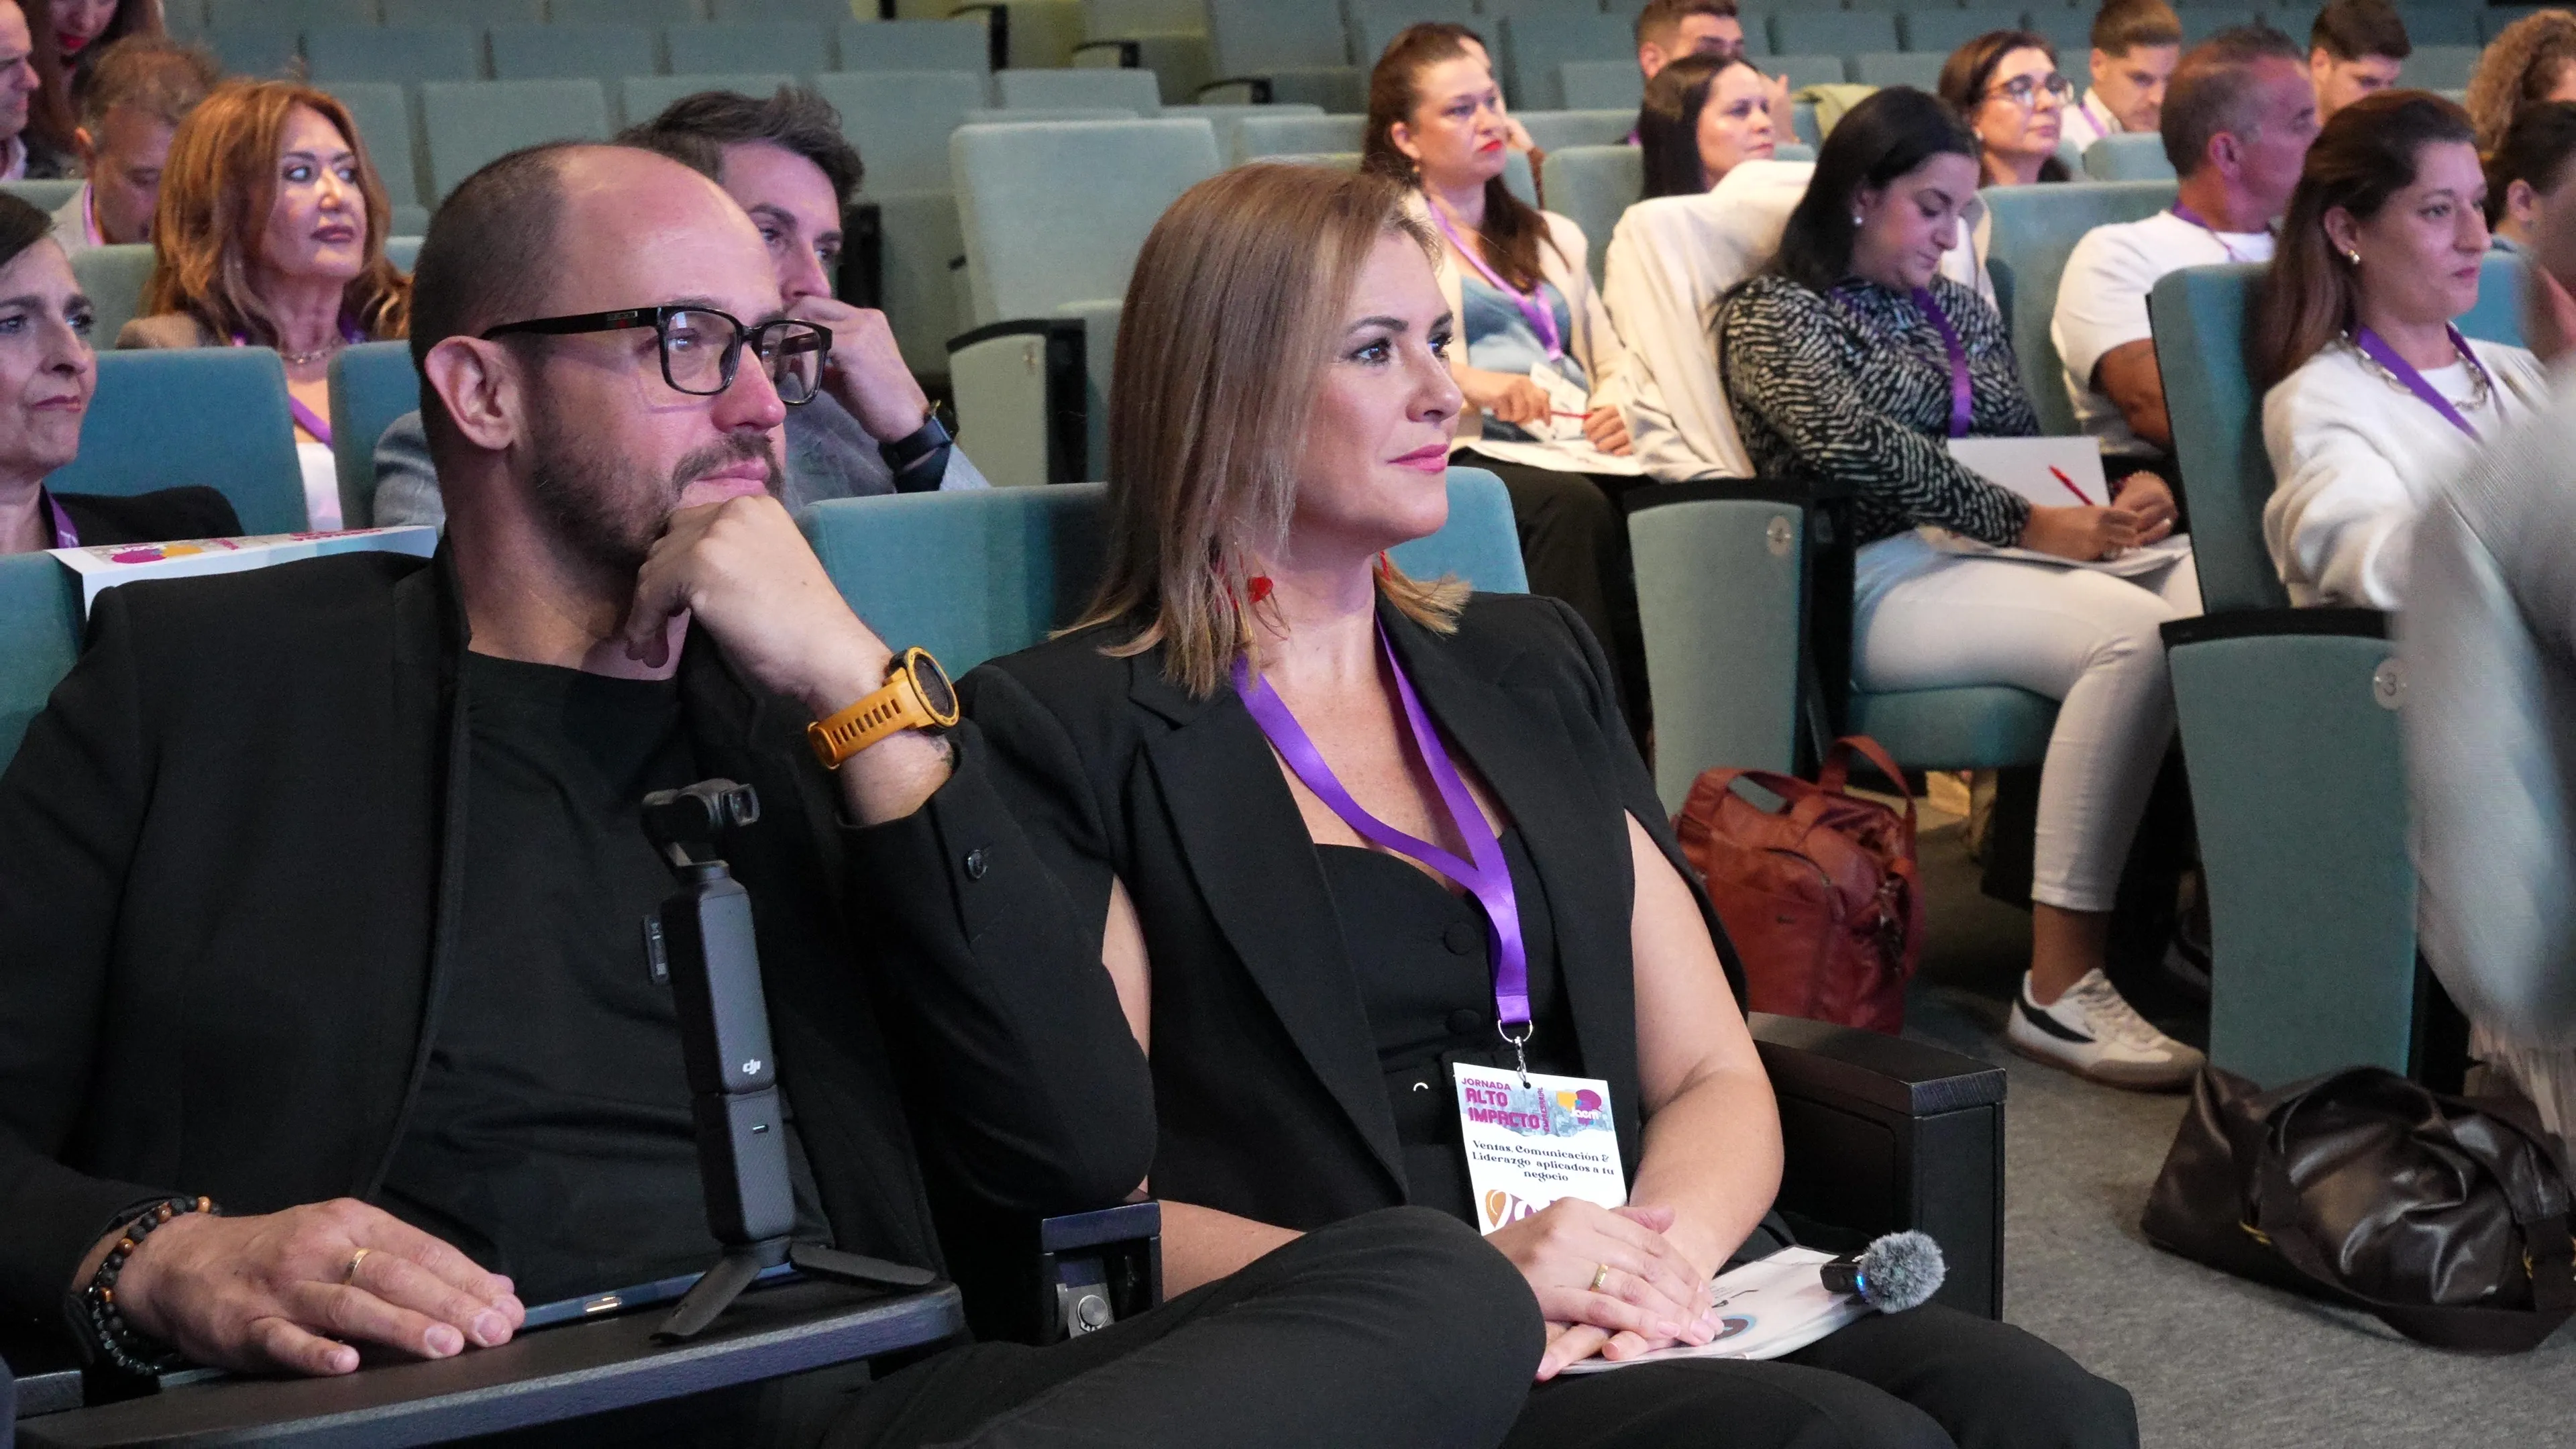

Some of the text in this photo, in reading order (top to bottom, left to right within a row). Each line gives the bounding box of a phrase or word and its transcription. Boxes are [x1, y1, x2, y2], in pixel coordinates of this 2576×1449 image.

[2383, 672, 2397, 696] 3
[1462, 1077, 1511, 1091] JORNADA
[1465, 1087, 1508, 1107] ALTO
[1467, 1107, 1540, 1130] IMPACTO
[1472, 1151, 1531, 1169] Liderazgo
[1536, 1161, 1590, 1172] aplicados
[1602, 1167, 1614, 1175] tu
[1515, 1144, 1599, 1162] Comunicación
[1601, 1154, 1609, 1163] &
[1523, 1171, 1568, 1183] negocio
